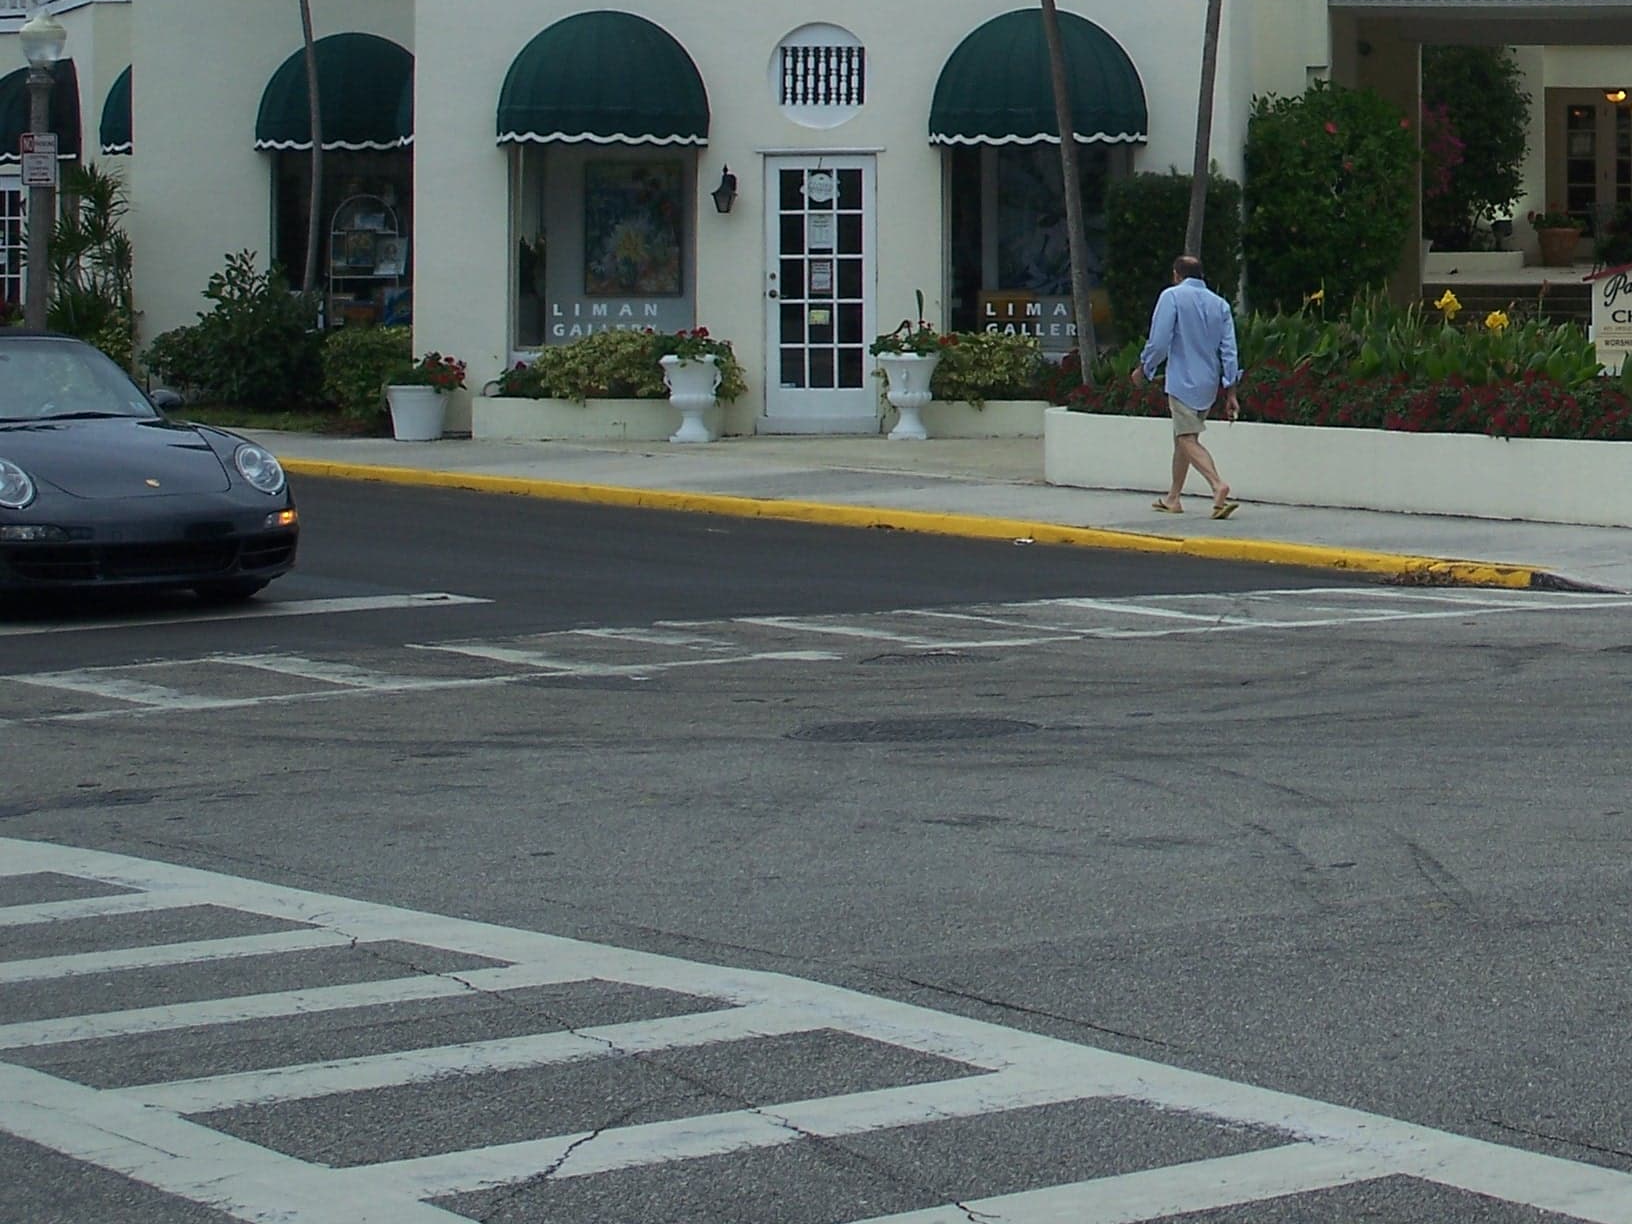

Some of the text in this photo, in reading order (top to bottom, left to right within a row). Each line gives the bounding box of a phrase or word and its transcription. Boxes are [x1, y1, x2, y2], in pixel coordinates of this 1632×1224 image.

[552, 303, 658, 317] LIMAN
[985, 303, 1093, 317] LIMA
[985, 323, 1078, 336] GALLER
